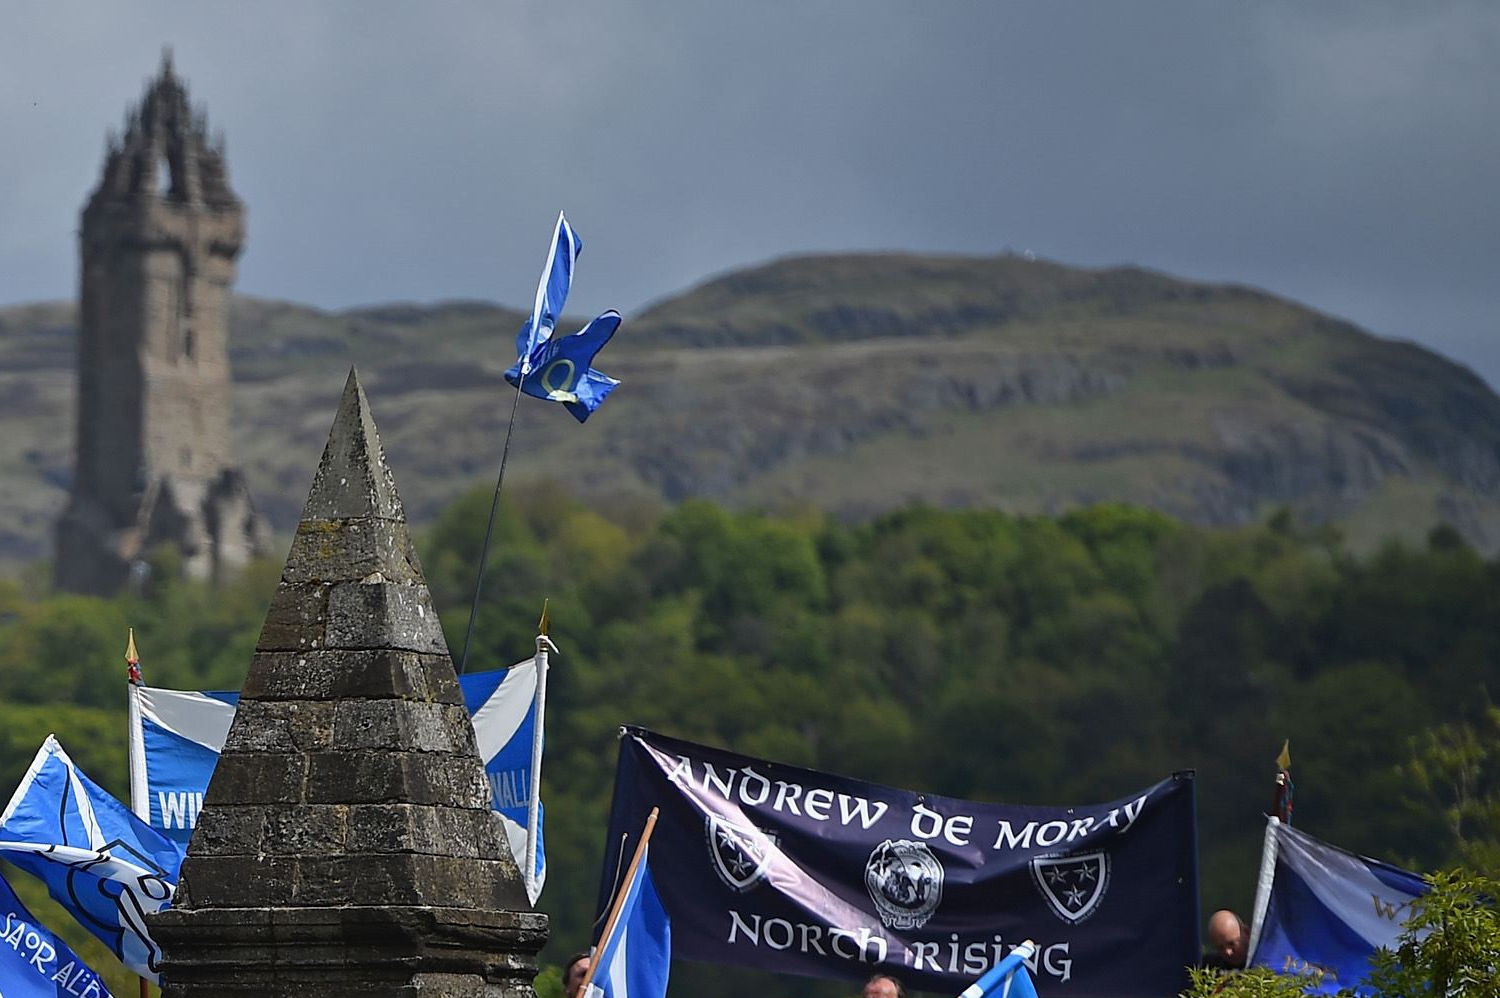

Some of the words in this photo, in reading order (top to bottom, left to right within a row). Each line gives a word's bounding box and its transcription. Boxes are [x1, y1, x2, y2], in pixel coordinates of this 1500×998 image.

[666, 755, 889, 830] ANDREW
[910, 803, 973, 846] DE
[992, 795, 1148, 850] MORAY
